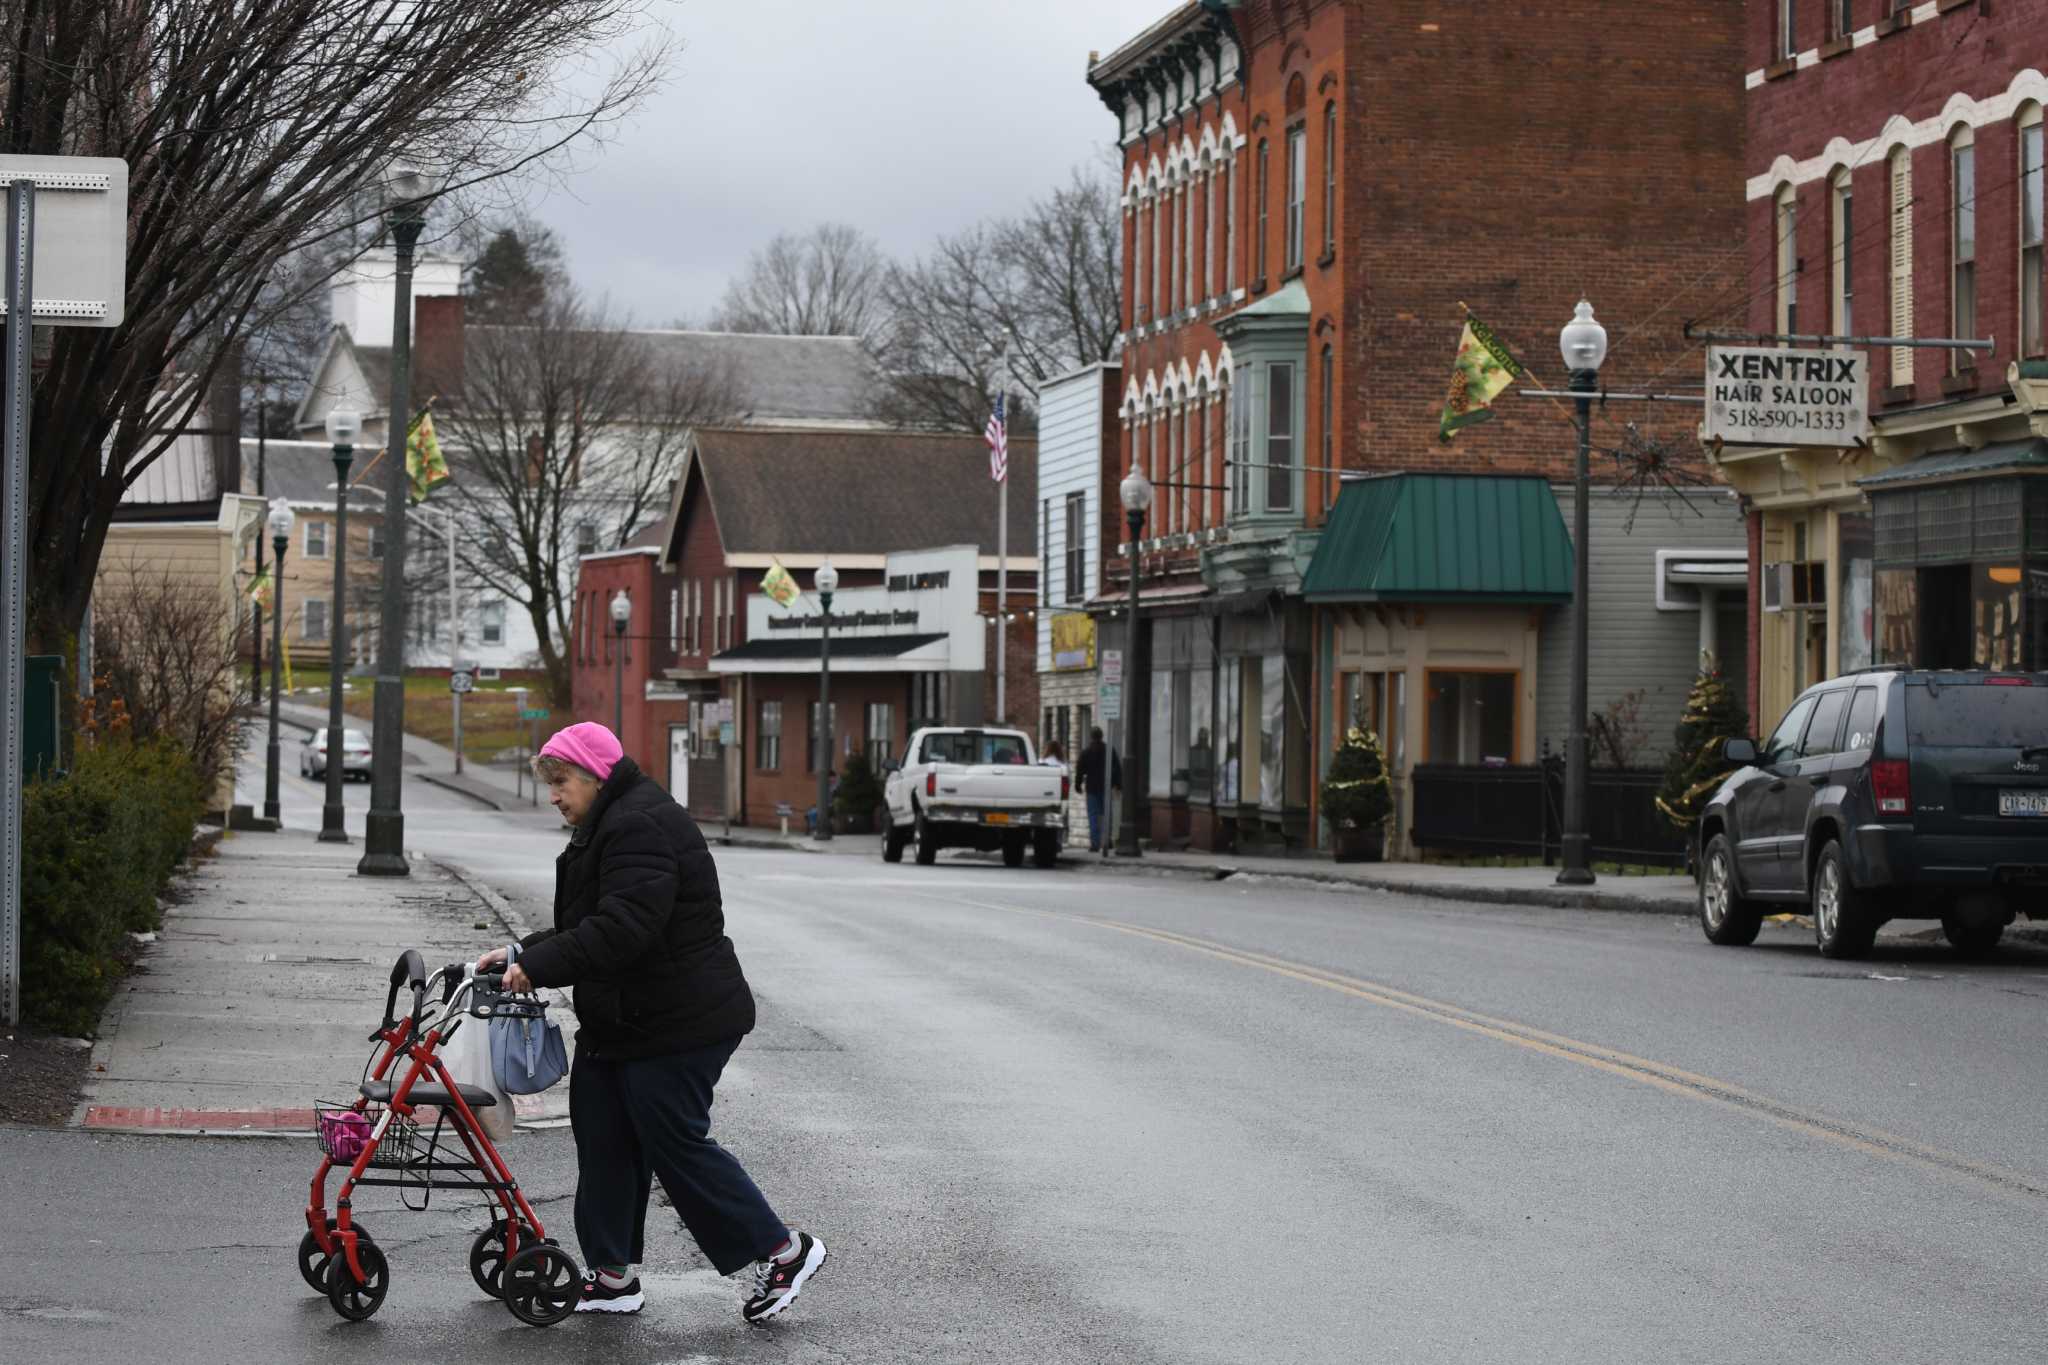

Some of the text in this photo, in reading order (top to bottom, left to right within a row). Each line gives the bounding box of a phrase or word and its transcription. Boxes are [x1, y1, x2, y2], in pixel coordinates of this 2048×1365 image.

[1718, 354, 1857, 383] XENTRIX
[1715, 385, 1852, 405] HAIR SALOON
[1727, 409, 1846, 430] 518-590-1333
[2014, 761, 2040, 773] Jeep
